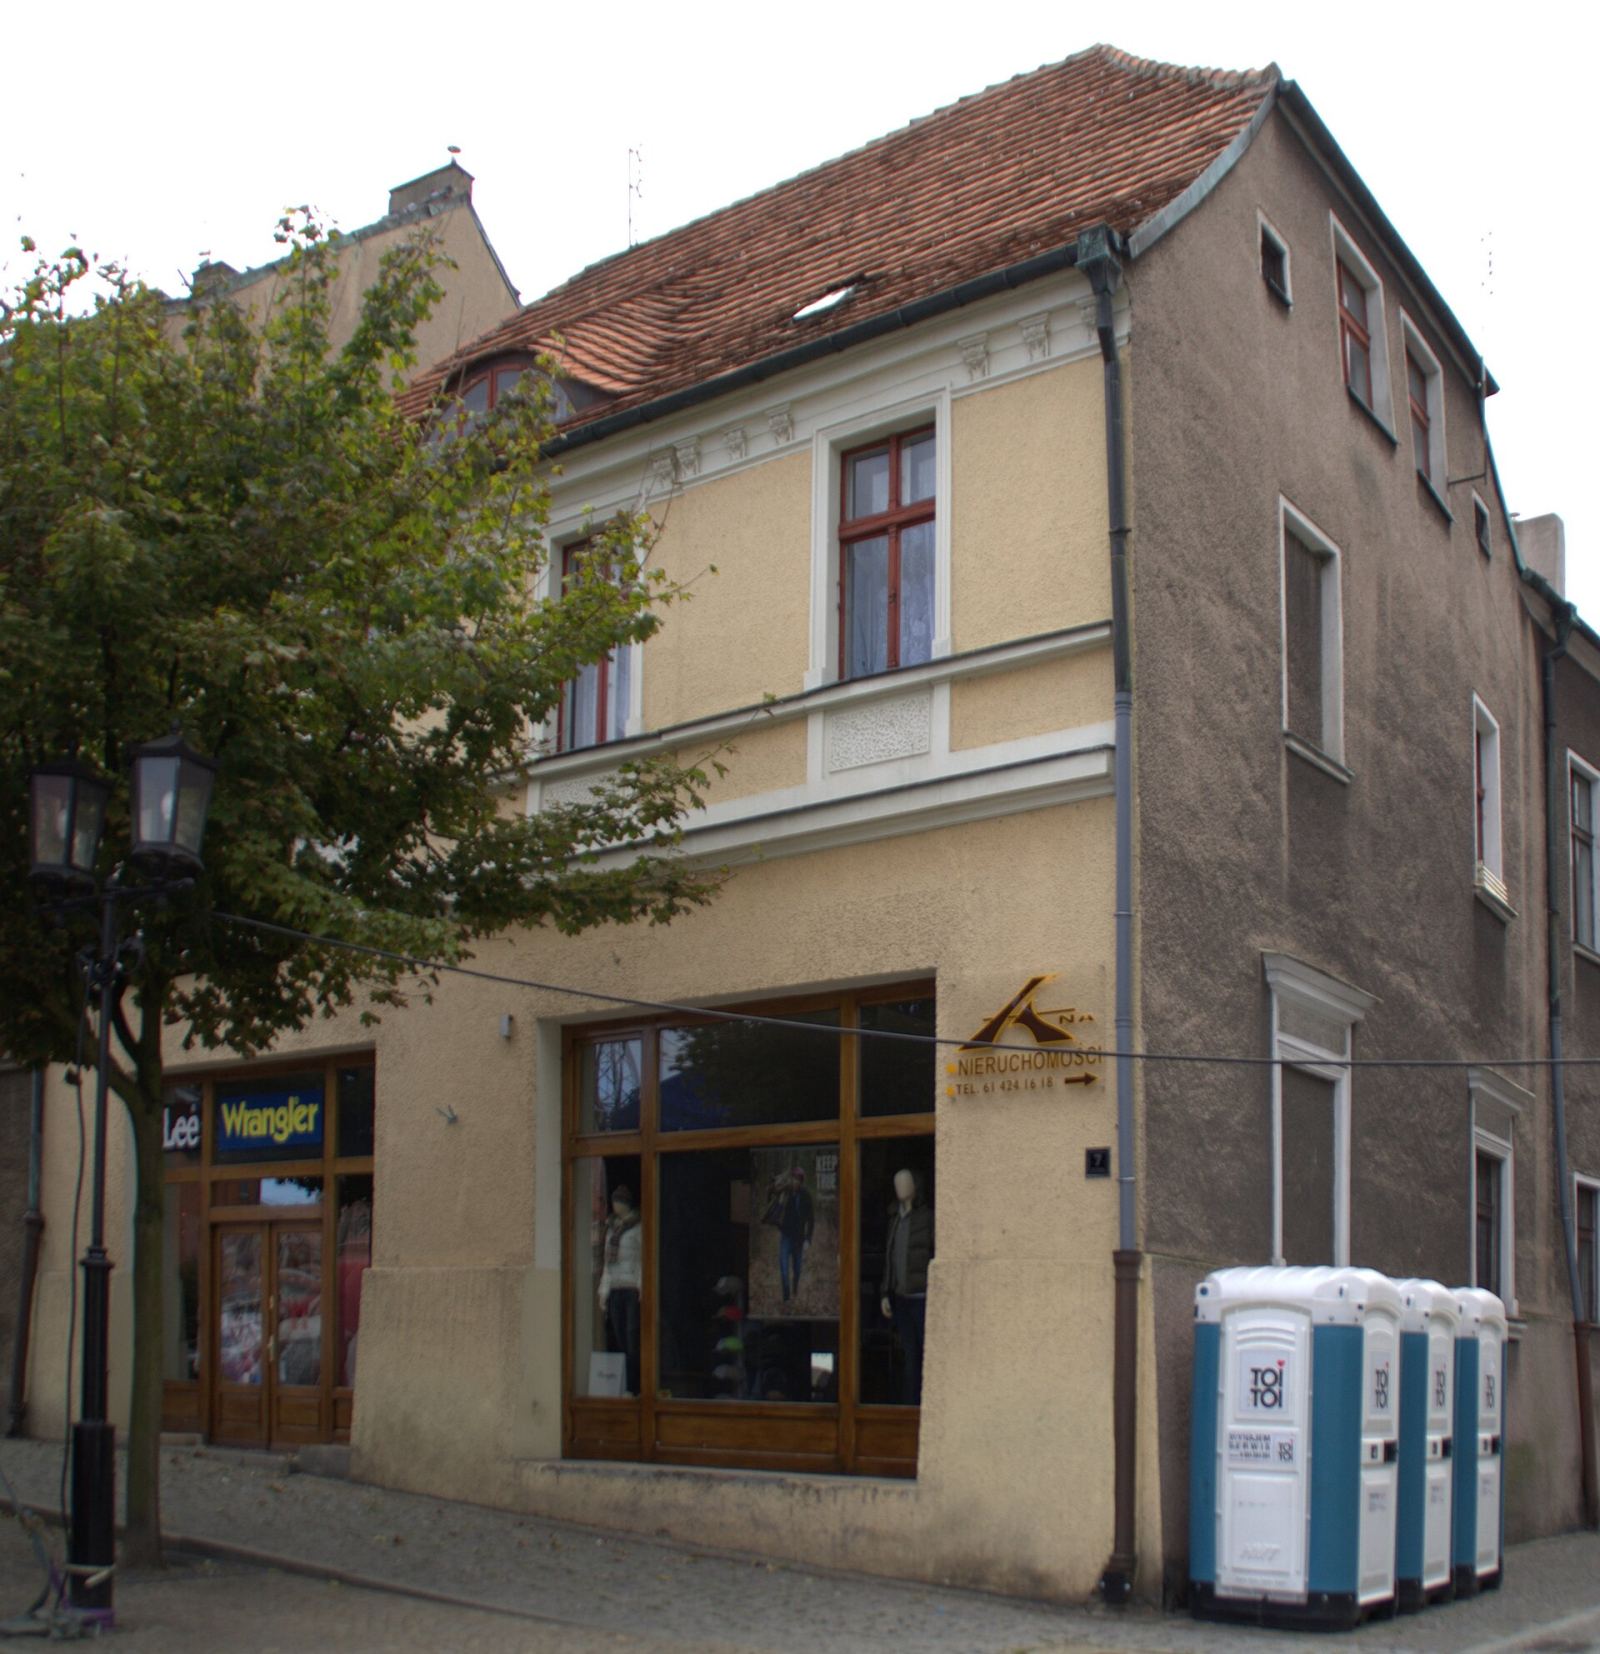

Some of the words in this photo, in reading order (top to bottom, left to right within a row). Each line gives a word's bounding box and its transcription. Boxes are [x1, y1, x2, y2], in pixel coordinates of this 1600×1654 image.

[956, 1083, 979, 1095] TEL.
[983, 1081, 995, 1093] 61
[1000, 1079, 1019, 1091] 424
[1025, 1078, 1036, 1089] 16
[163, 1107, 200, 1149] Lee
[221, 1096, 319, 1143] Wrangler
[1250, 1388, 1283, 1408] TOI
